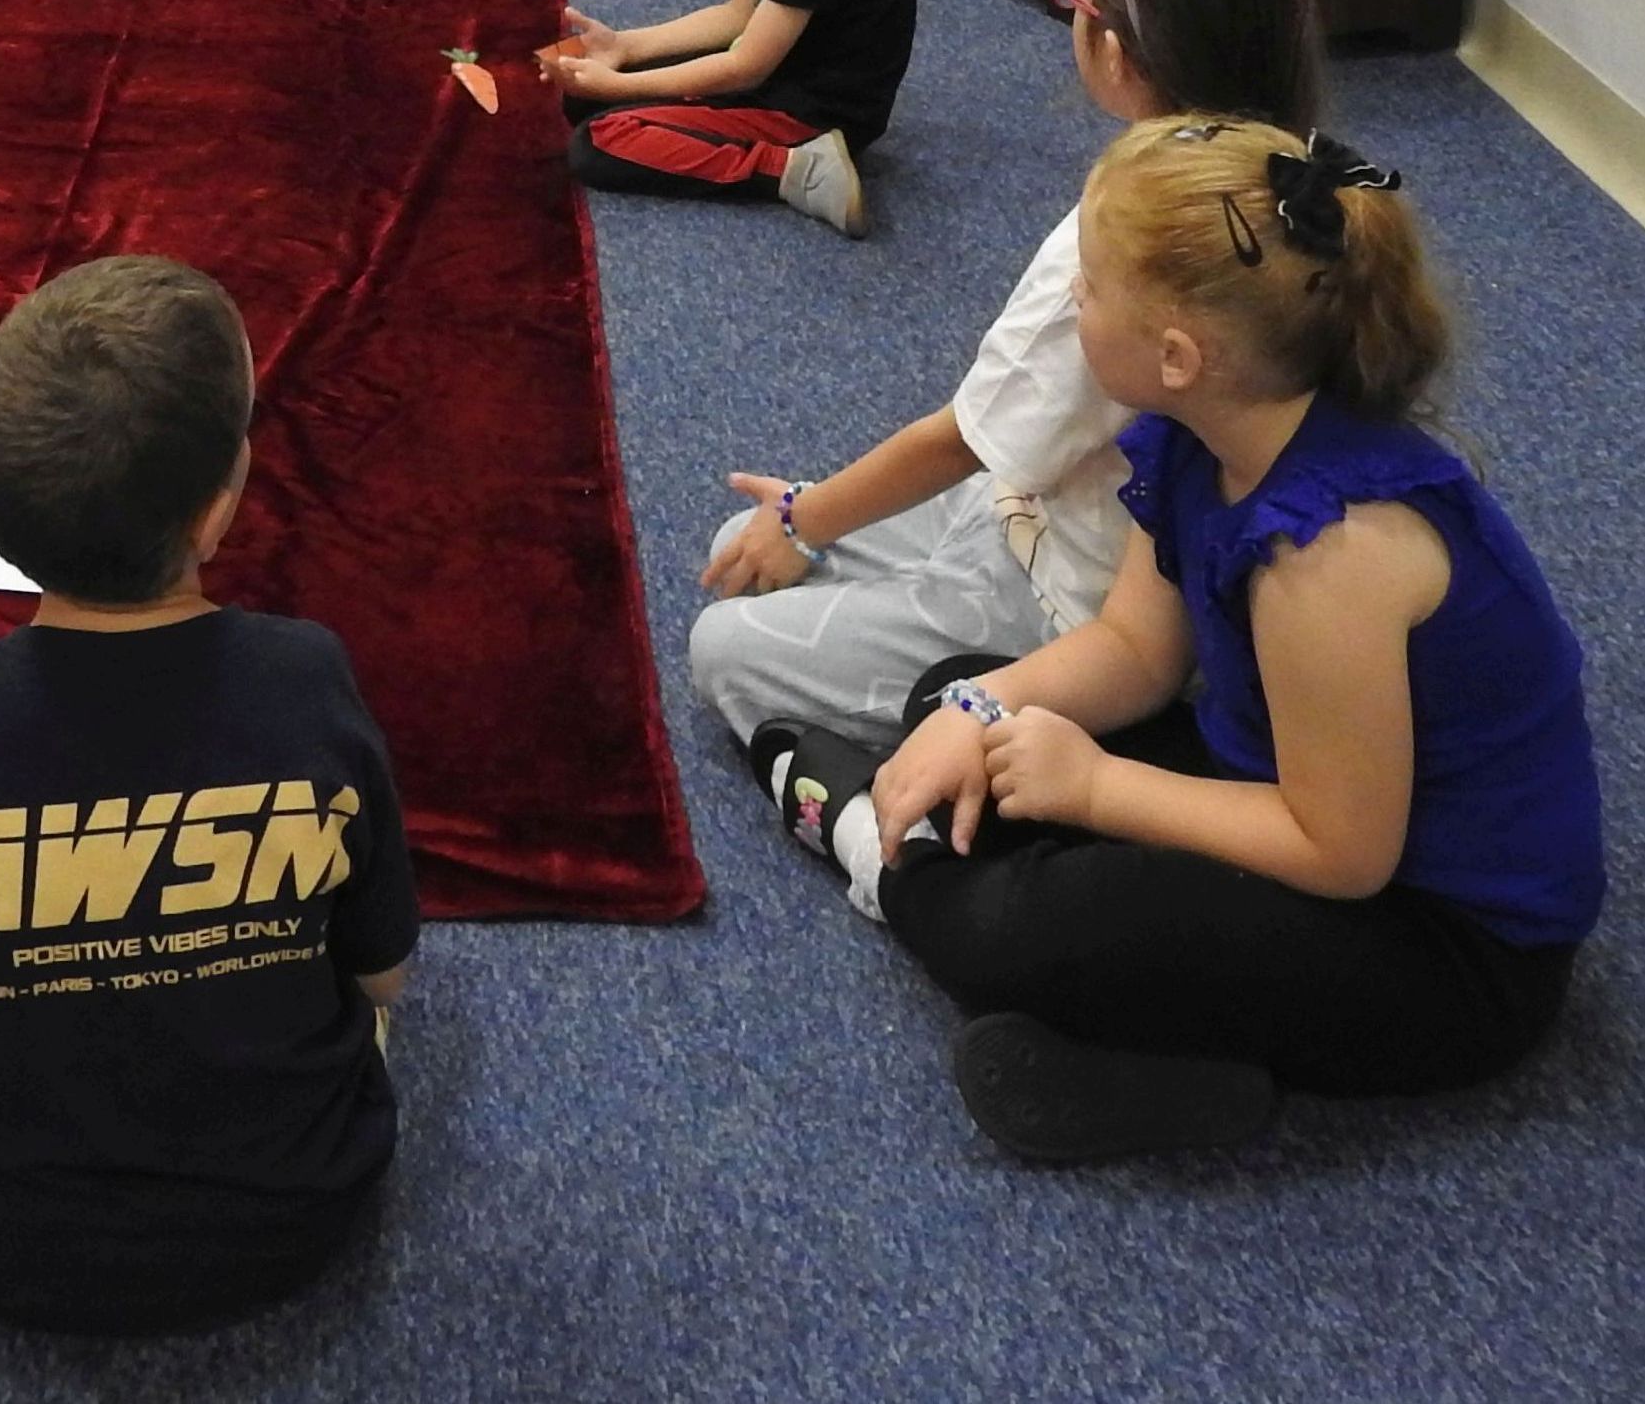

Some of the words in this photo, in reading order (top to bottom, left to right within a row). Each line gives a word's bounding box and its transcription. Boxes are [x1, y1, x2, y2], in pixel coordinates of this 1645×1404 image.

[12, 937, 142, 968] POSITIVE
[148, 924, 229, 955] VIBES
[234, 916, 302, 941] ONLY
[33, 976, 94, 997] PARIS
[110, 969, 179, 991] TOKYO
[196, 947, 314, 980] WORLDWIDE
